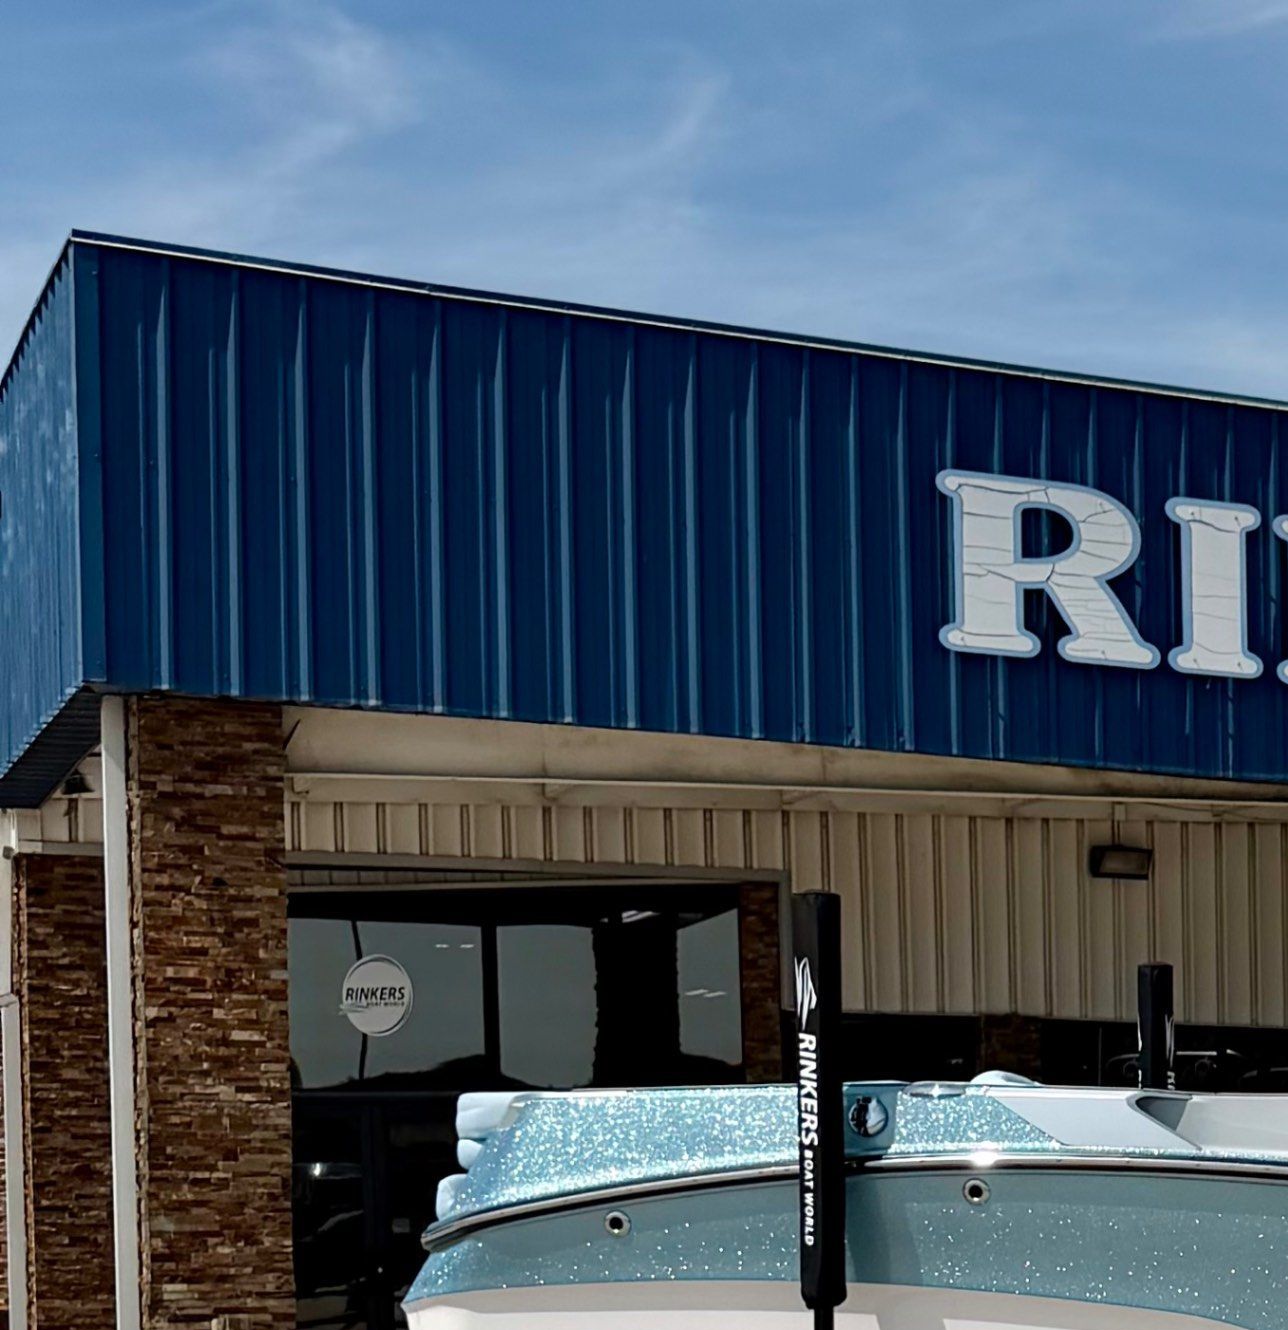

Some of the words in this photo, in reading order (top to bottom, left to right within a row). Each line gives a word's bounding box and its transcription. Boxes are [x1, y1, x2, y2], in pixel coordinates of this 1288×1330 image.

[345, 986, 405, 1001] RINKERS
[799, 1032, 818, 1146] RINKERS
[804, 1149, 814, 1190] BOAT
[804, 1193, 815, 1246] WORLD
